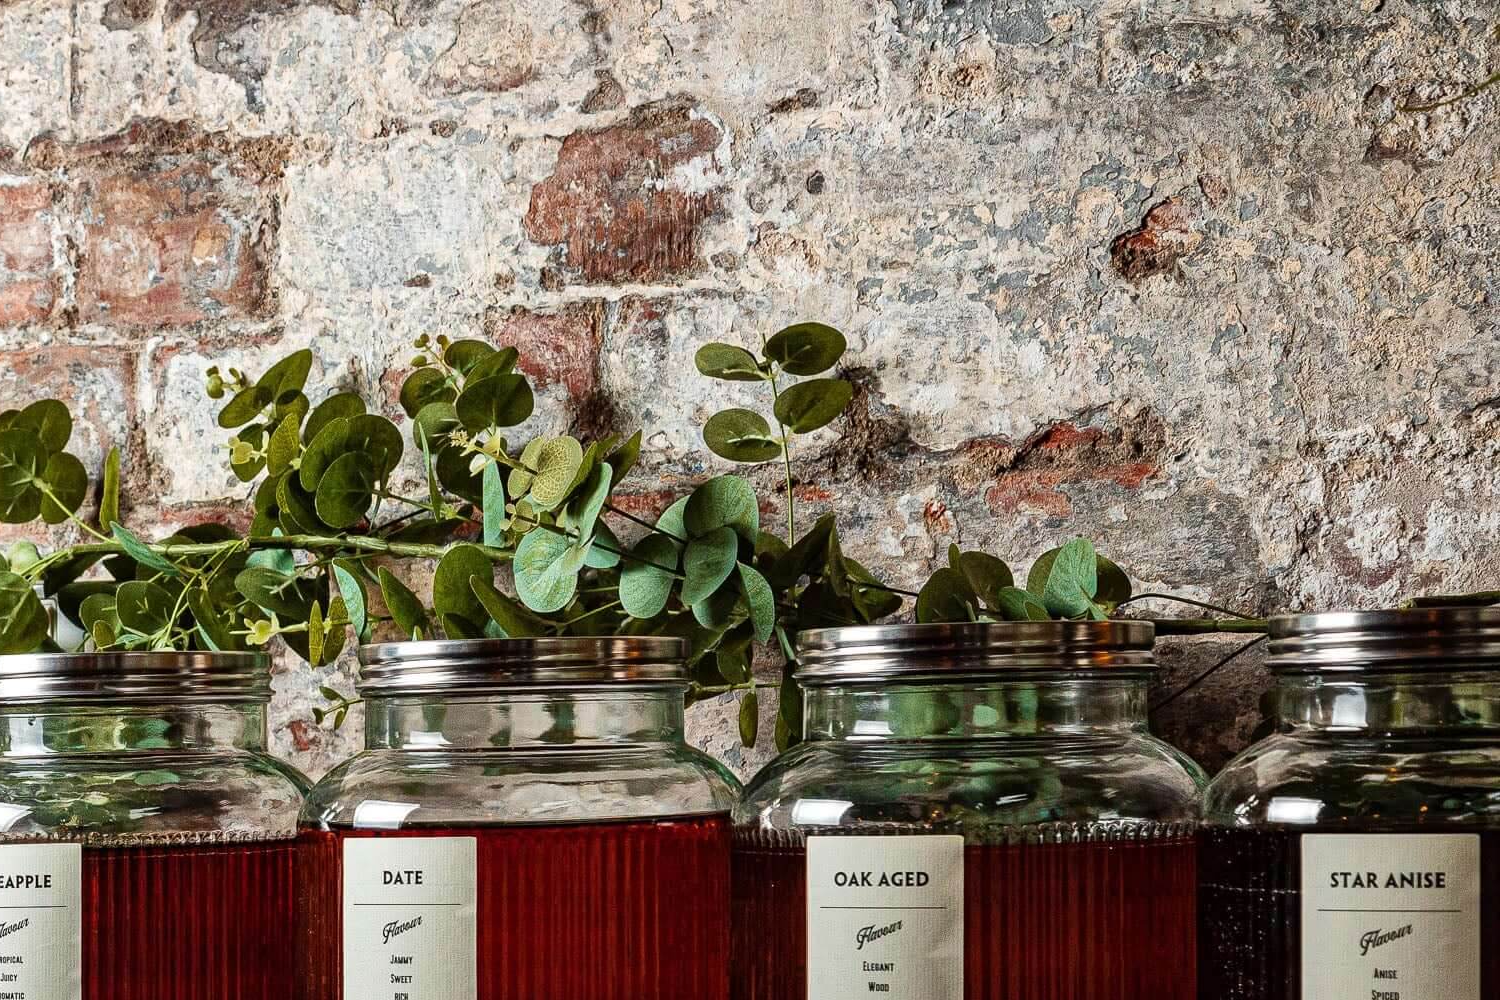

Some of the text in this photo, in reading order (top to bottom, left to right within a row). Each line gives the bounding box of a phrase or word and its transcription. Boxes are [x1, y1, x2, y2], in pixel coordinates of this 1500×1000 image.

[383, 870, 423, 885] DATE
[834, 871, 929, 887] OAK AGED
[1330, 872, 1446, 888] STAR ANISE
[382, 915, 422, 944] Flavour
[856, 920, 902, 950] Flavour
[1359, 924, 1412, 956] Flavour
